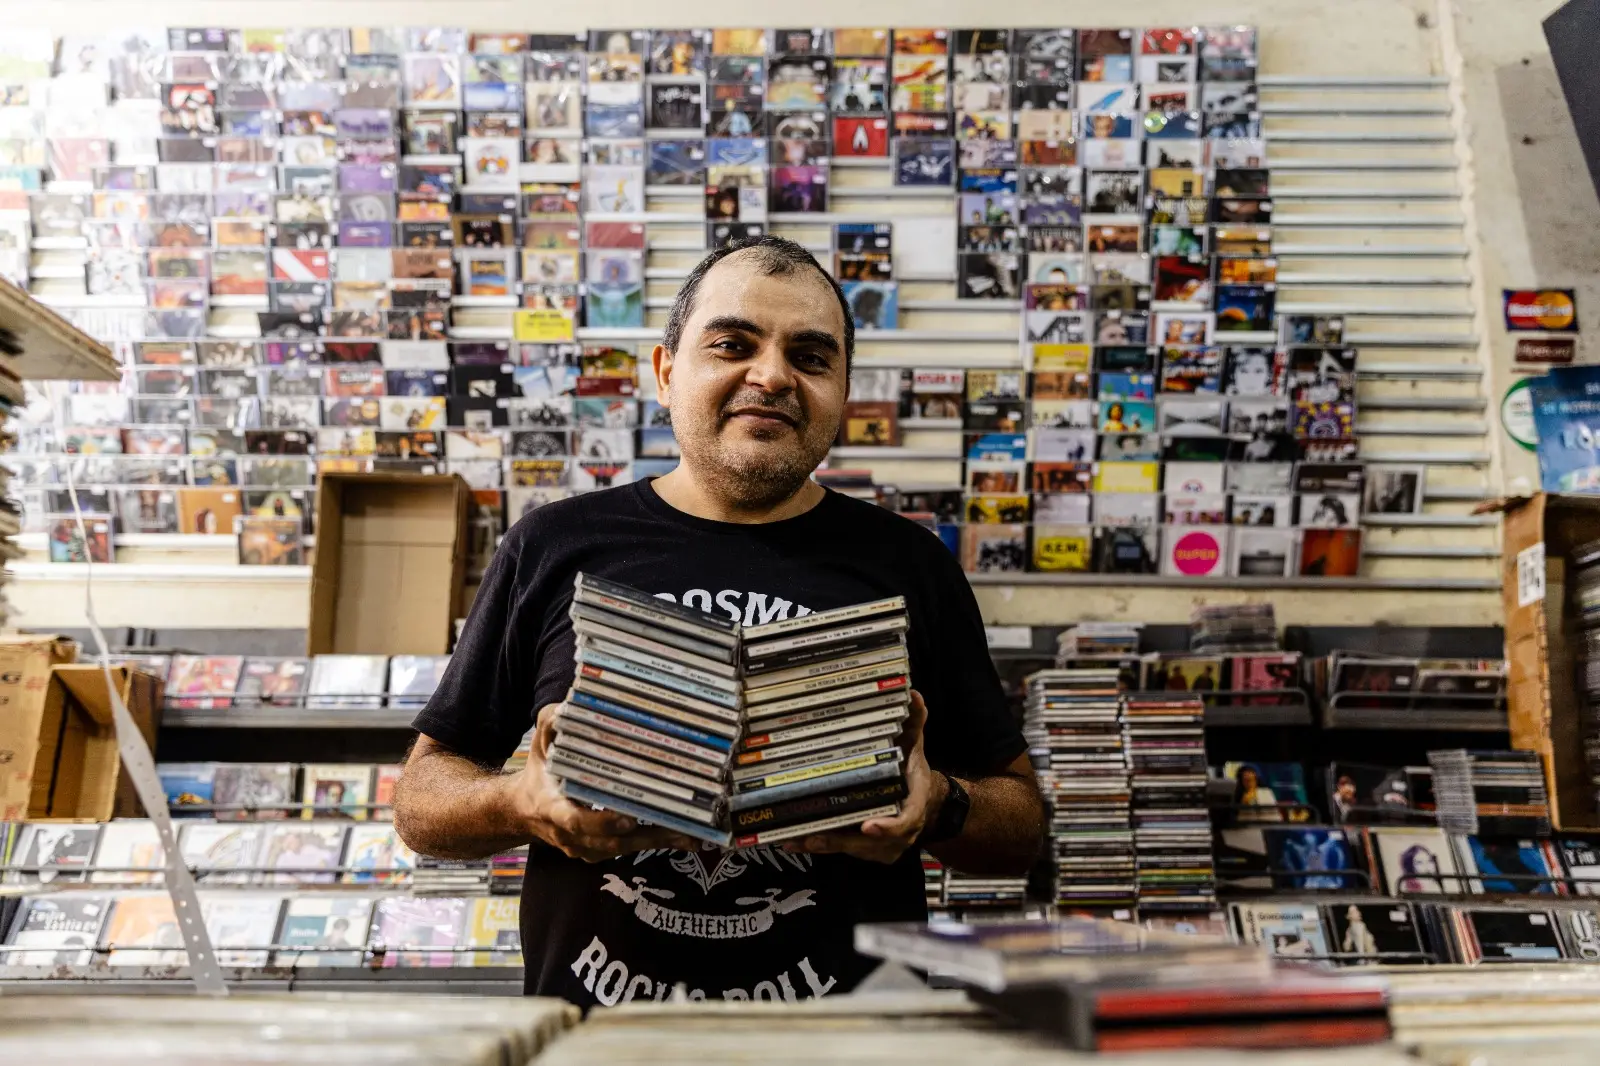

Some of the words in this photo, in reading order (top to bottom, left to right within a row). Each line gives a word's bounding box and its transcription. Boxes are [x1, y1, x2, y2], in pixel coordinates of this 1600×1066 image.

[738, 808, 774, 825] OSCAR
[829, 796, 848, 805] The
[652, 910, 758, 935] AUTHENTIC
